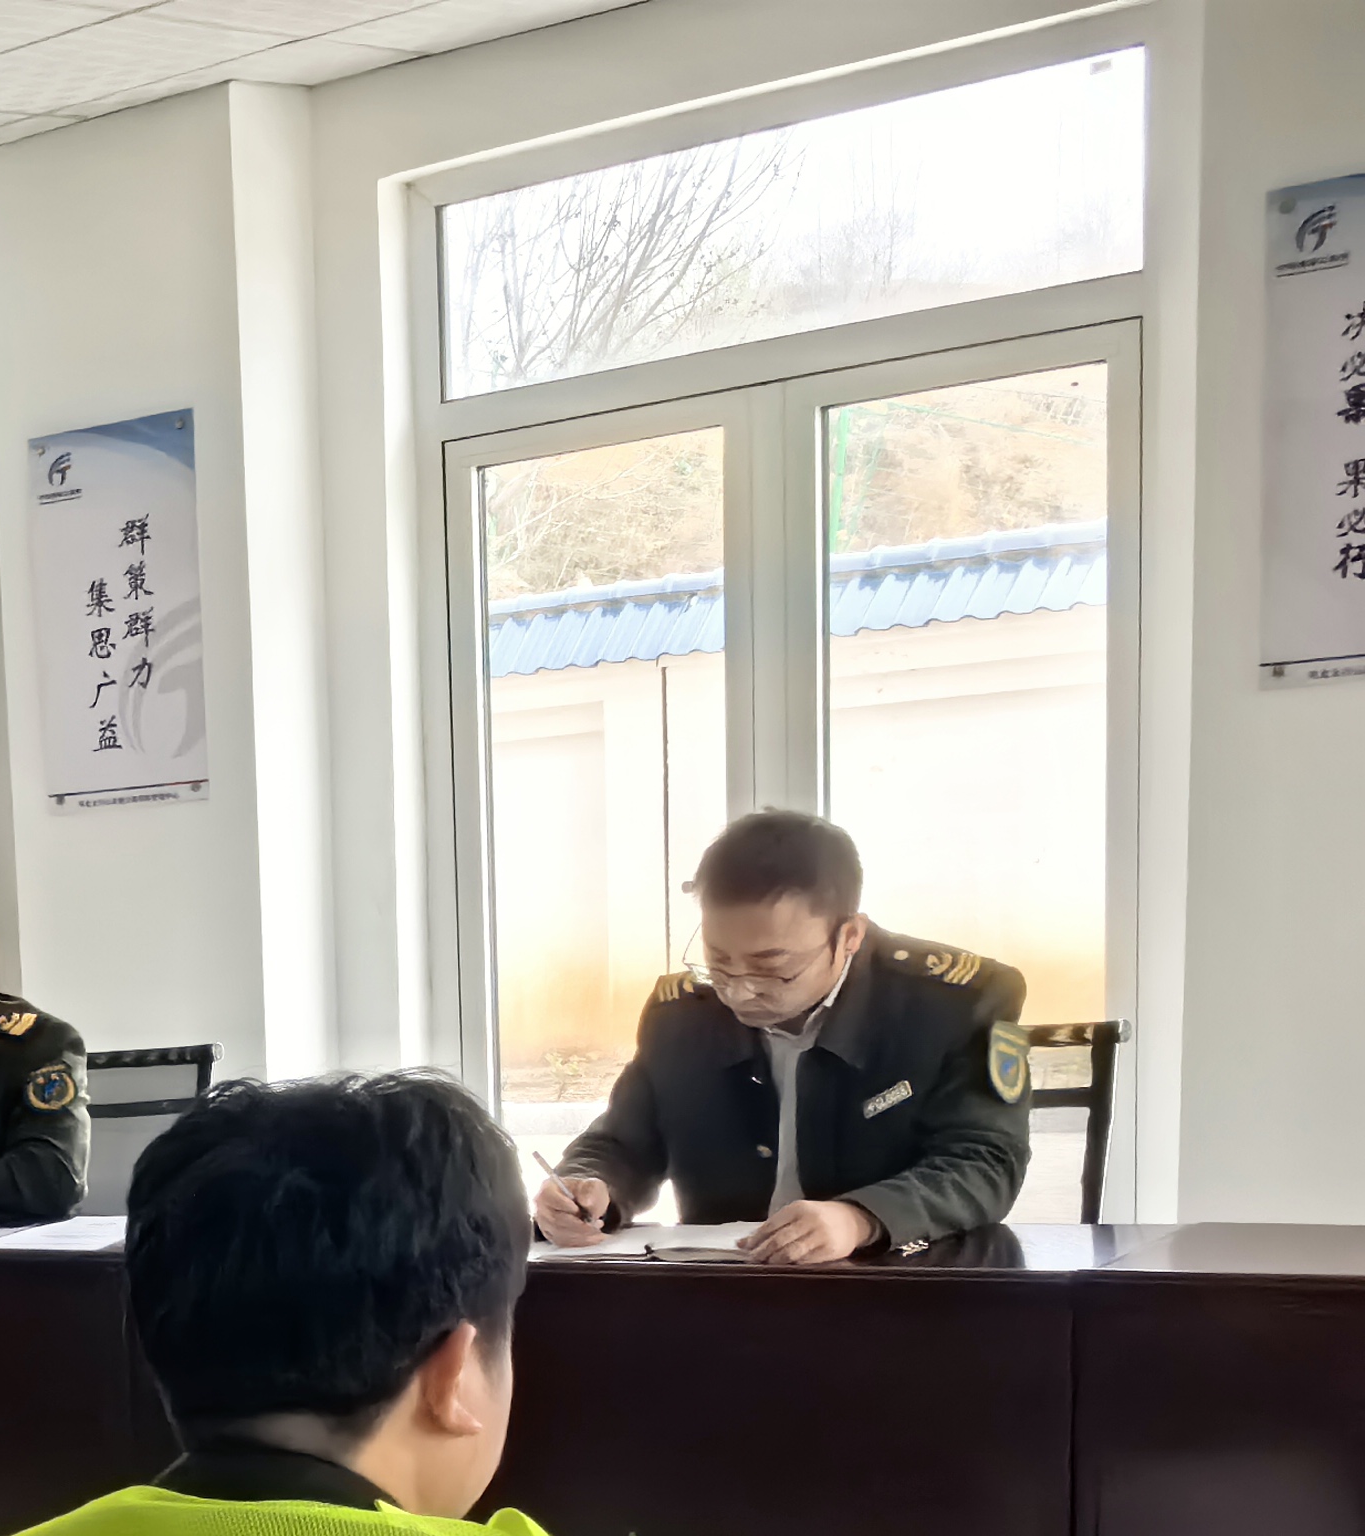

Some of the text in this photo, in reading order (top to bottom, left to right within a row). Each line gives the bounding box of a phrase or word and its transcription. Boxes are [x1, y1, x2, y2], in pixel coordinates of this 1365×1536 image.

[86, 578, 123, 753] 集思广益
[118, 513, 156, 691] 群策群力
